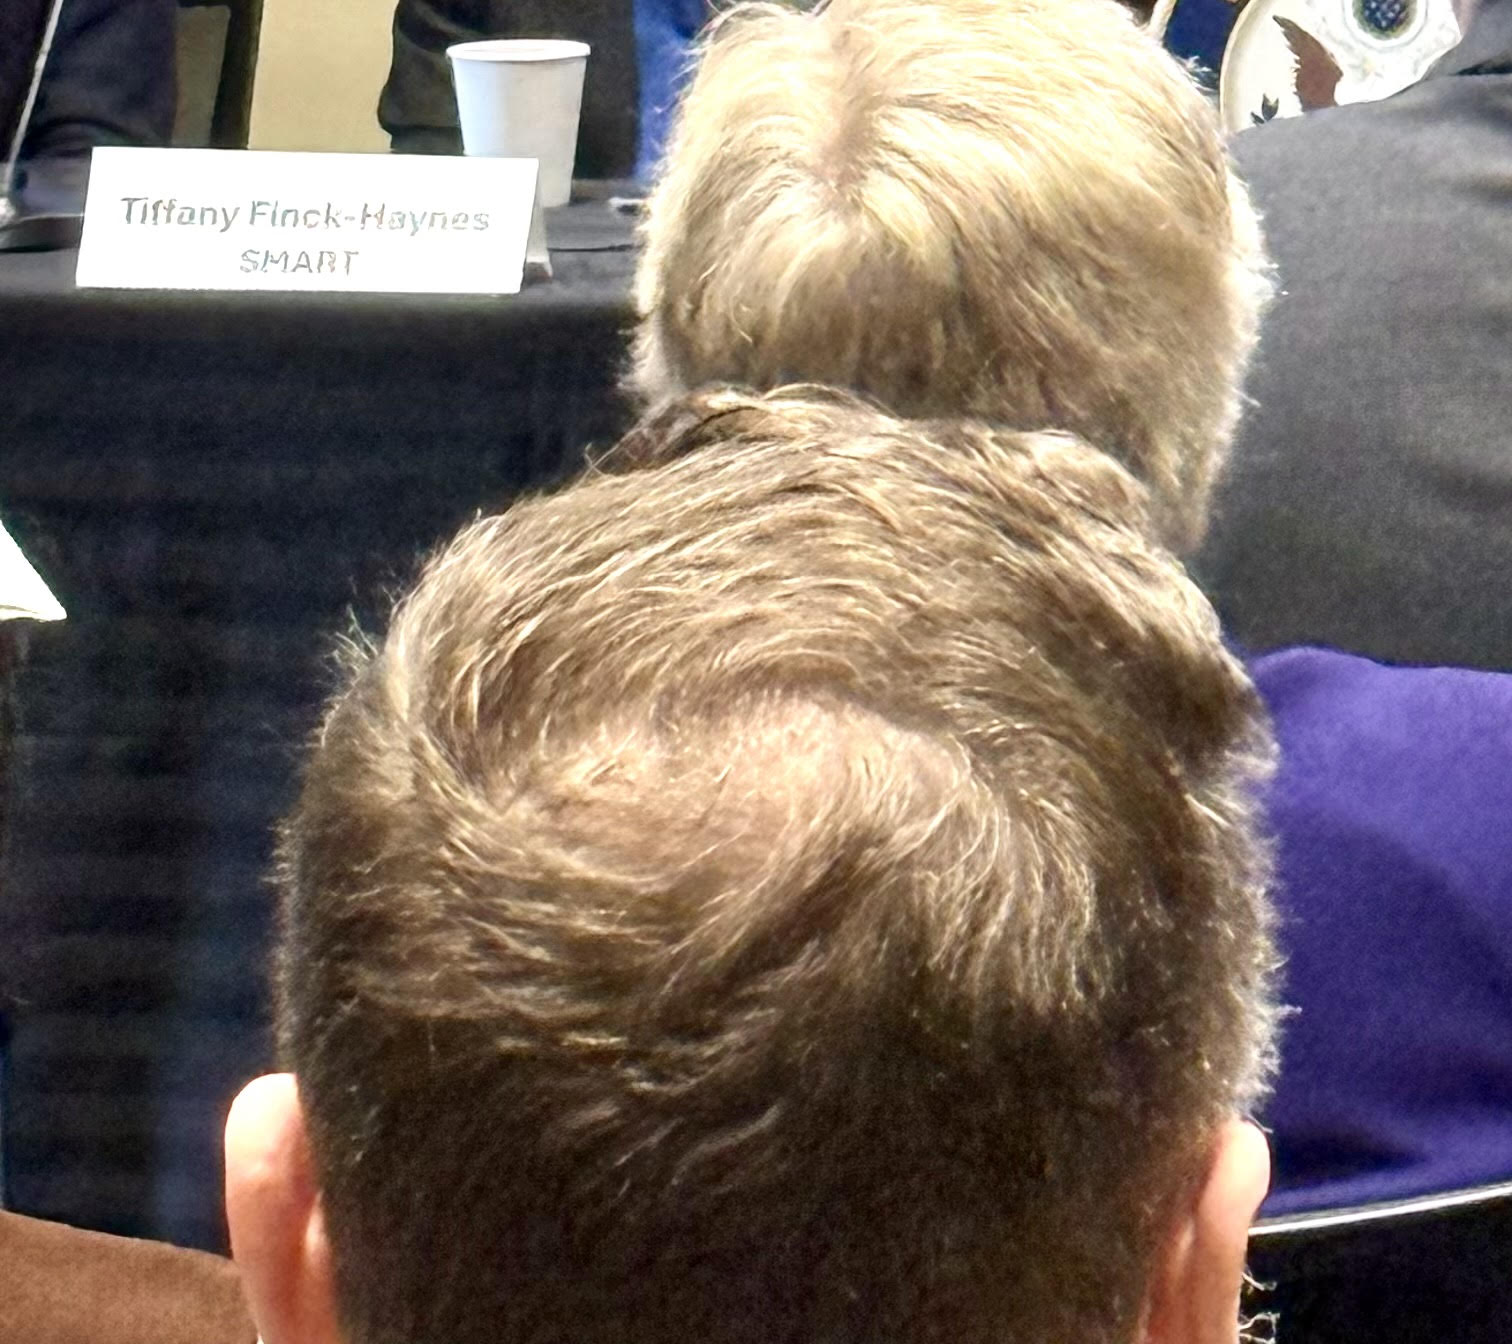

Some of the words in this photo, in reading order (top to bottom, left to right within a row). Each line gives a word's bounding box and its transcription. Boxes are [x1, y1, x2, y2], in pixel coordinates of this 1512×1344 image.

[119, 195, 241, 234] Tiffany
[250, 199, 491, 237] Finck-Haynes
[238, 247, 361, 277] SMART
